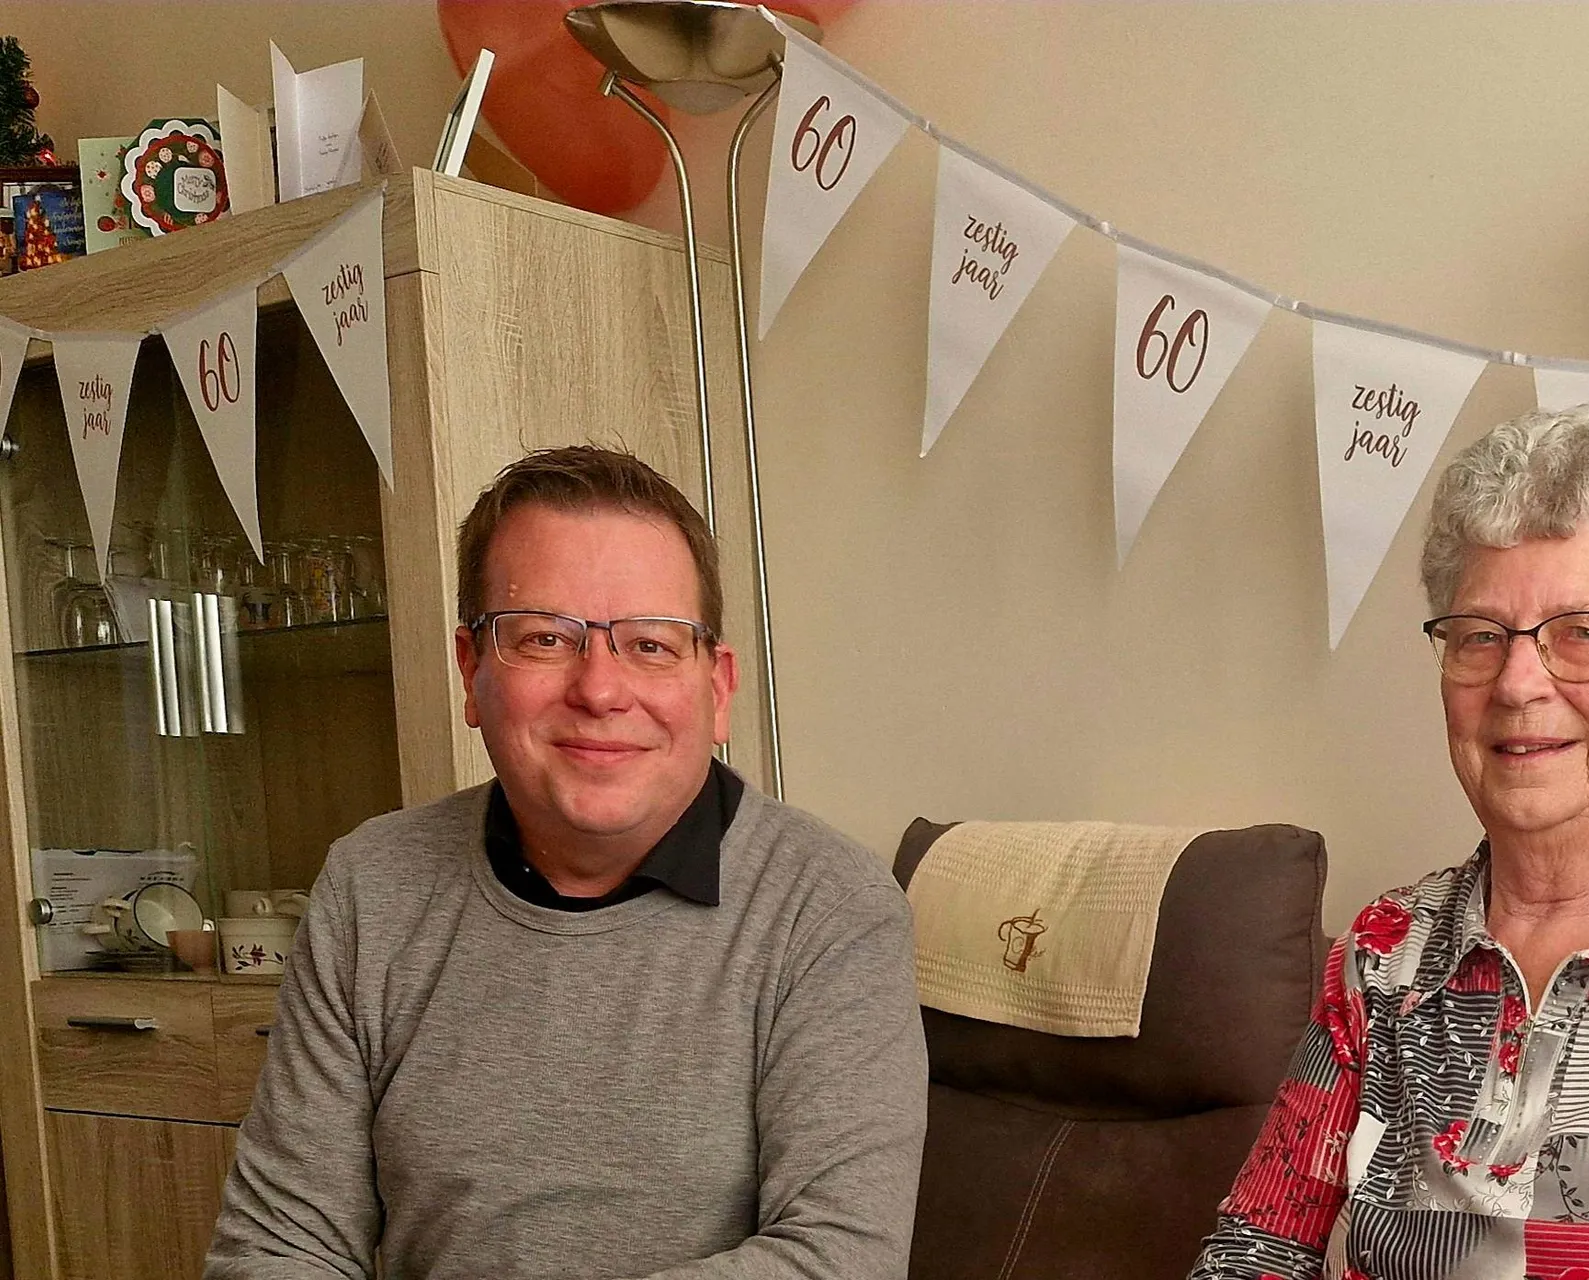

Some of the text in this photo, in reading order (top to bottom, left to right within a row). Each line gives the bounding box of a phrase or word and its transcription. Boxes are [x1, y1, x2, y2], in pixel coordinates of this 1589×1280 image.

[791, 95, 857, 192] 60
[963, 214, 1020, 275] zestig
[321, 263, 365, 306] zestig
[951, 247, 1005, 301] jaar
[332, 296, 369, 347] jaar
[1136, 294, 1209, 395] 60
[78, 374, 113, 411] zestig
[198, 331, 242, 413] 60
[82, 407, 112, 440] jaar
[1351, 383, 1422, 439] zestig
[1343, 420, 1408, 468] jaar
